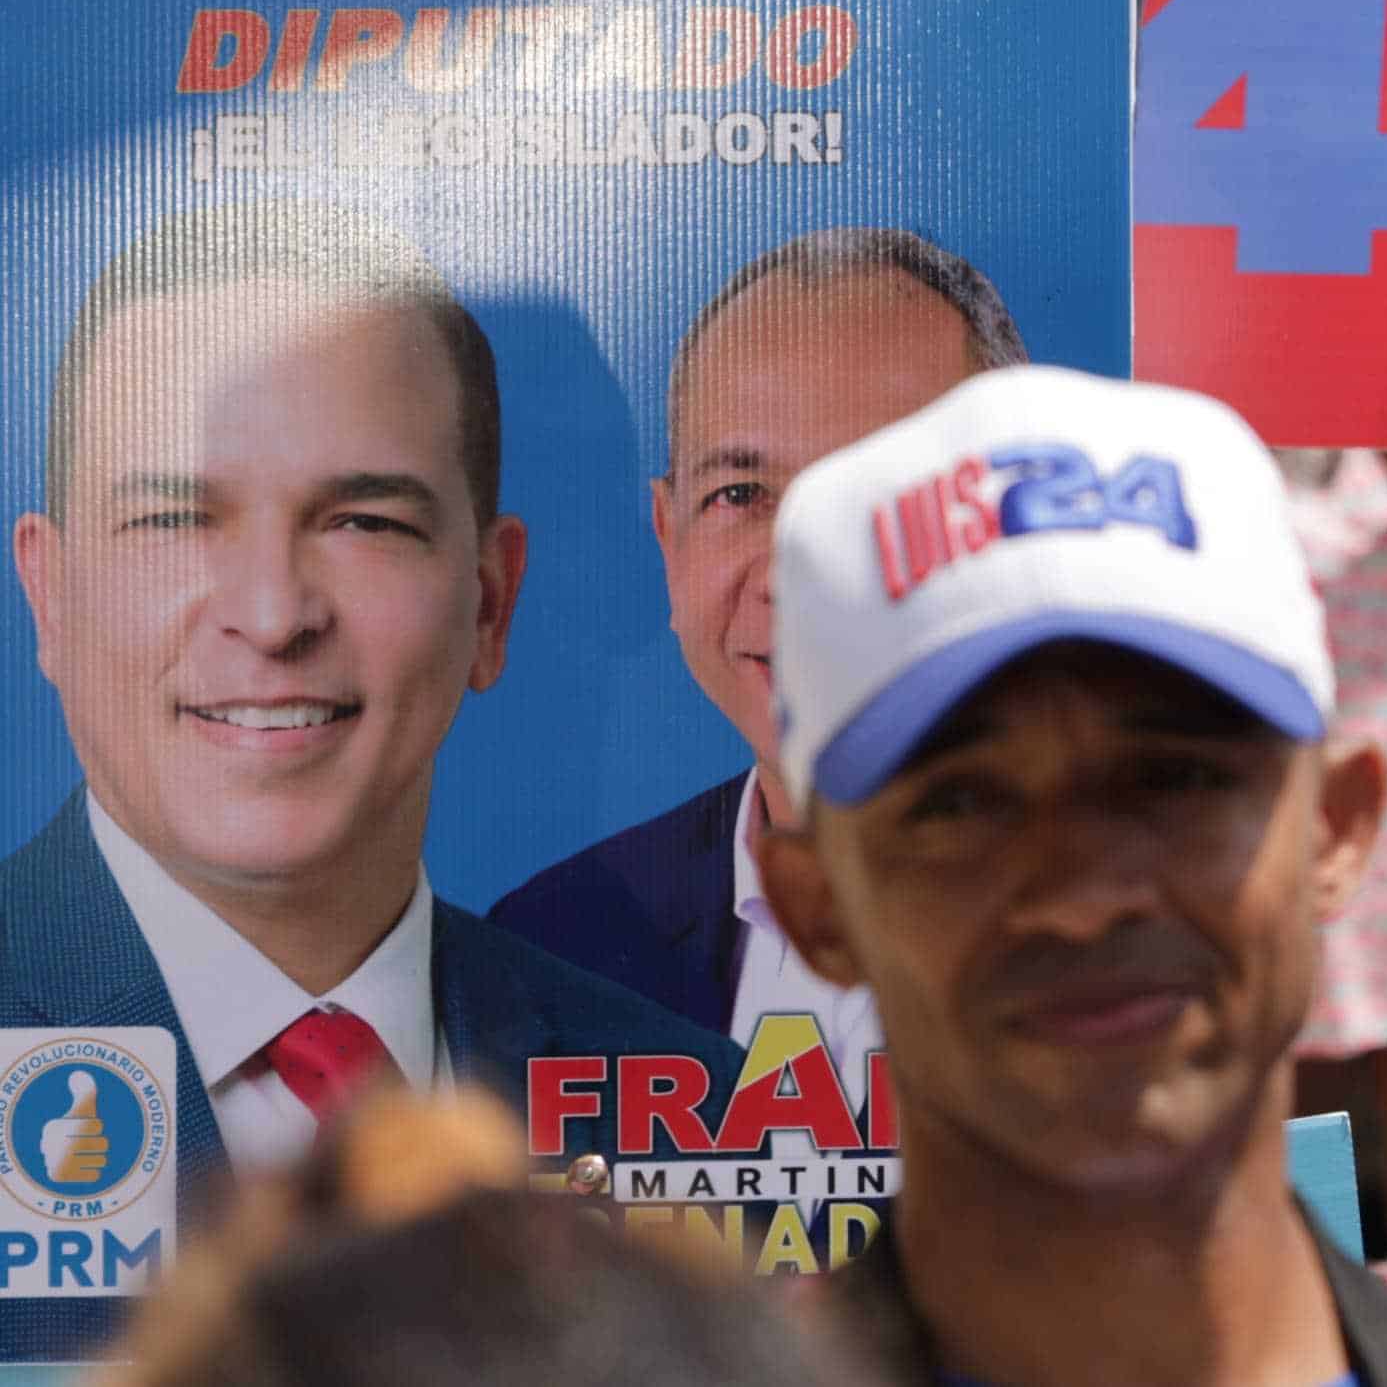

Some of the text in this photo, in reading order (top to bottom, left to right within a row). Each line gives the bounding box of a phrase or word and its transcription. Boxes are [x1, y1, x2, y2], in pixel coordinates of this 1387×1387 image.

[176, 4, 859, 93] DIPUTADO
[335, 112, 844, 167] LEGISLADOR!
[3, 1043, 165, 1174] REVOLUCIONARIO MODERNO
[52, 1200, 104, 1218] PRM
[0, 1227, 161, 1288] PRM
